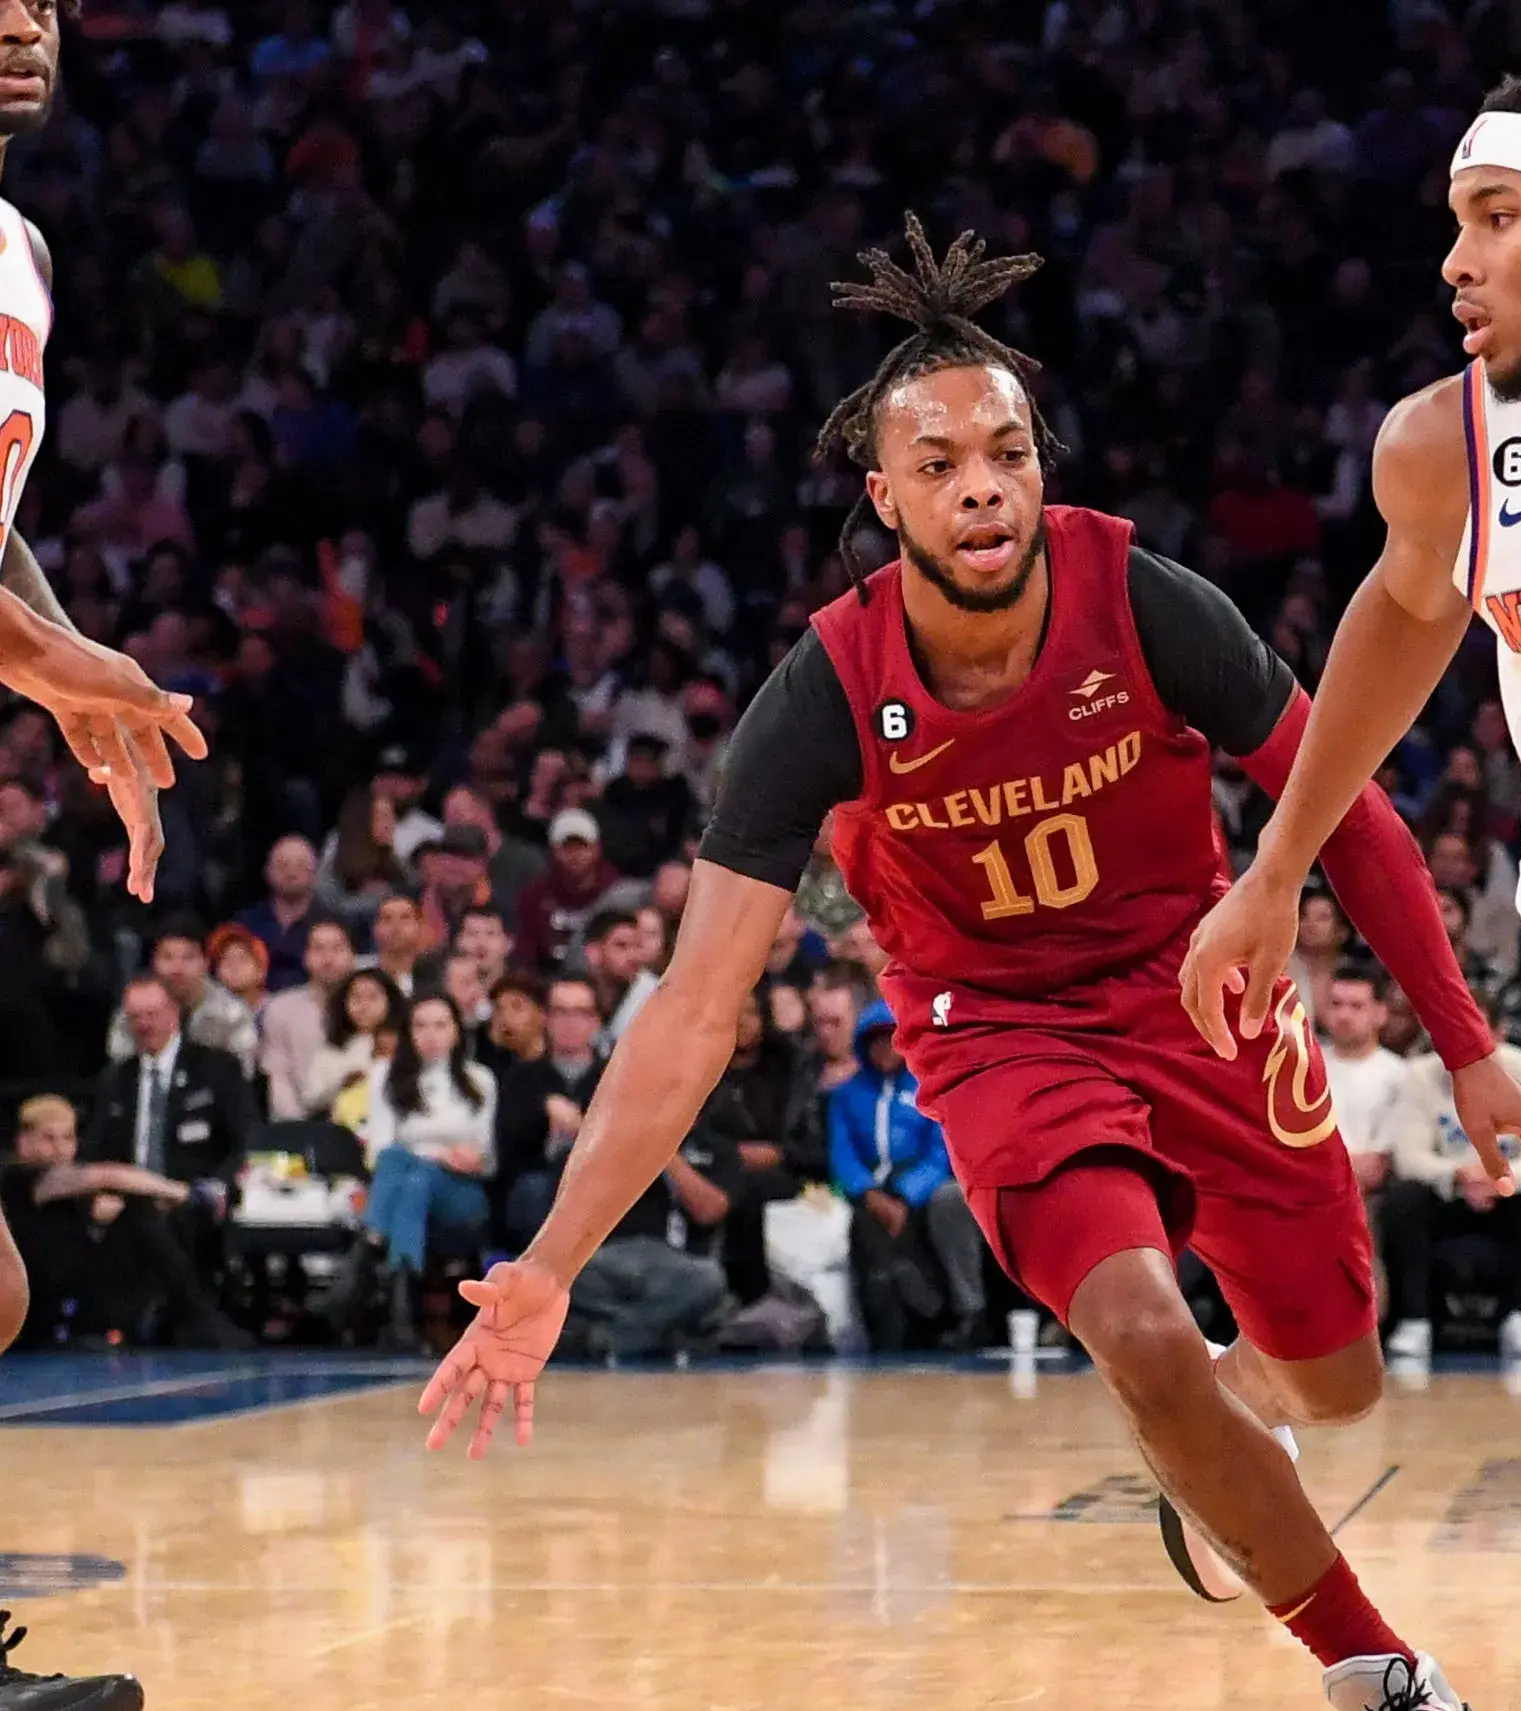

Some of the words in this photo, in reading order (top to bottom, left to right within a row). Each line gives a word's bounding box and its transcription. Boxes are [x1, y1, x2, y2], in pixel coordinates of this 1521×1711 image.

[881, 704, 908, 740] 6
[1068, 691, 1130, 721] CLIFFS
[885, 730, 1142, 830] CLEVELAND
[971, 812, 1100, 921] 10
